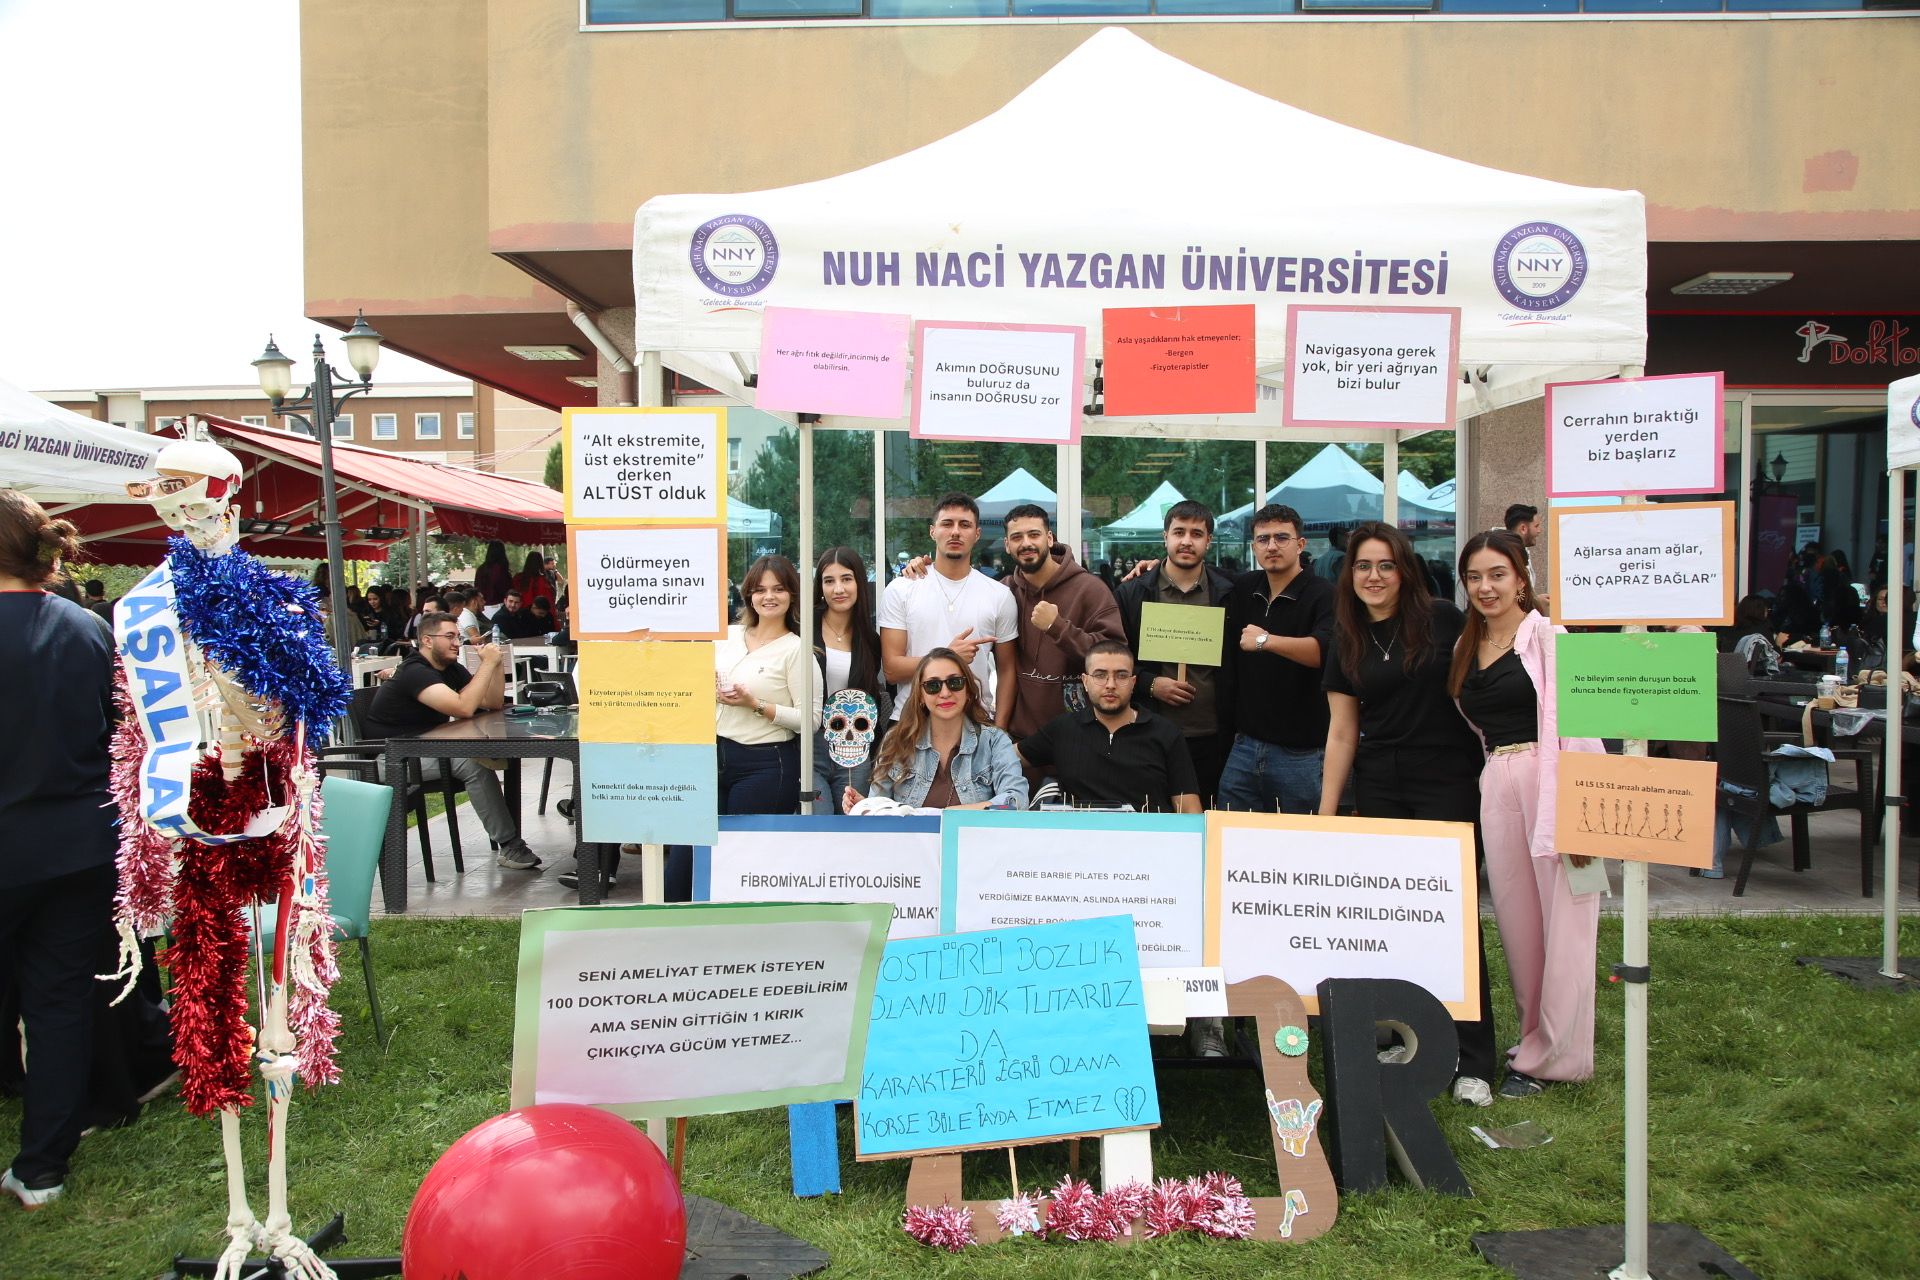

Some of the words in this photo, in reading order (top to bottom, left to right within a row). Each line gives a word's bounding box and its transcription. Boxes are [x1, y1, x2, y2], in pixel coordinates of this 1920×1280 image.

[713, 248, 755, 260] NNY
[823, 251, 900, 286] NUH
[916, 244, 1004, 288] NACİ
[1018, 253, 1165, 289] YAZGAN
[1182, 246, 1448, 295] ÜNİVERSİTESİ
[1518, 258, 1563, 272] NNY
[1829, 320, 1920, 366] Dokto
[1165, 350, 1194, 358] -Bergen
[1306, 344, 1393, 358] Navigasyona
[1397, 346, 1436, 359] gerek
[813, 363, 850, 371] olabilirsin.
[935, 362, 976, 373] Akımın
[979, 362, 1060, 376] DOĞRUSUNU
[1150, 363, 1209, 372] -Fizyoterapistler
[1302, 360, 1330, 374] yok,
[1335, 361, 1353, 372] bir
[1357, 361, 1382, 375] yeri
[1387, 362, 1437, 376] ağrıyan
[967, 377, 1012, 389] buluruz
[1015, 379, 1030, 390] da
[1337, 377, 1361, 389] bizi
[1365, 378, 1401, 390] bulur
[930, 390, 972, 402] insanın
[975, 391, 1037, 404] DOĞRUSU
[1041, 397, 1060, 405] zor
[1563, 413, 1628, 427] Cerrahın
[1634, 408, 1698, 424] bıraktığı
[583, 434, 612, 447] "Alt
[617, 434, 704, 449] ekstremite,
[1605, 429, 1658, 446] yerden
[0, 429, 21, 449] ACİ
[23, 435, 71, 457] YAZGAN
[73, 440, 150, 470] ÜNİVERSİTESİ
[1588, 449, 1610, 461] biz
[1615, 447, 1676, 463] başlarız
[585, 453, 608, 466] üst
[613, 453, 704, 466] ekstremite"
[617, 468, 671, 481] derken
[161, 482, 184, 492] FTR
[583, 483, 653, 500] ALTÜST
[659, 485, 706, 500] olduk
[1574, 546, 1622, 559] Ağlarsa
[1626, 546, 1661, 555] anam
[1665, 544, 1702, 556] ağlar,
[601, 554, 690, 571] Öldürmeyen
[1619, 559, 1655, 573] gerisi
[587, 575, 657, 590] uygulama
[662, 577, 704, 587] sınavı
[1566, 574, 1591, 586] "ÖN
[1595, 575, 1649, 588] ÇAPRAZ
[1654, 572, 1716, 584] BAĞLAR"
[609, 593, 688, 609] güçlendirir
[1587, 675, 1615, 683] bileyim
[1639, 675, 1671, 683] duruşun
[1623, 687, 1671, 696] fizyoterapist
[120, 570, 207, 839] AŞALLAH
[741, 872, 826, 888] FİBROMİYALJİ
[829, 873, 921, 888] ETİYOLOJİSİNE
[1006, 870, 1038, 878] BARBİE
[1041, 871, 1072, 879] BARBİE
[1074, 872, 1109, 880] PİLATES
[1113, 873, 1150, 881] POZLARI
[1228, 869, 1287, 885] KALBİN
[1293, 872, 1401, 890] KIRILDIĞINDA
[1406, 876, 1453, 892] DEĞİL
[979, 893, 1033, 902] VERDİĞİMİZE
[1151, 897, 1176, 905] HARBİ
[1232, 900, 1331, 918] KEMİKLERİN
[1337, 906, 1445, 923] KIRILDIĞINDA
[1132, 920, 1164, 929] IKIYOR.
[1289, 936, 1322, 950] GEL
[1327, 937, 1388, 952] YANIMA
[882, 937, 1003, 982] OSTÜRÜ
[1016, 937, 1122, 972] BOZUK
[579, 968, 616, 982] SENİ
[620, 965, 699, 980] AMELİYAT
[703, 963, 756, 975] ETMEK
[761, 960, 825, 973] İSTEYEN
[547, 998, 573, 1009] 100
[579, 993, 668, 1008] DOKTORLA
[672, 987, 758, 1002] MÜCADELE
[763, 980, 848, 996] EDEBİLİRİM
[959, 986, 1009, 1017] DİK
[1017, 980, 1139, 1014] TUTARIZ
[590, 1021, 626, 1033] AMA
[630, 1016, 677, 1030] SENİN
[682, 1011, 747, 1027] GİTTİĞİN
[753, 1012, 758, 1022] 1
[765, 1008, 804, 1021] KIRIK
[587, 1044, 665, 1060] ÇIKIKÇIYA
[670, 1038, 726, 1053] GÜCÜM
[731, 1033, 801, 1048] YETMEZ...
[955, 1028, 1007, 1062] DA
[860, 1059, 986, 1100] KARAKTERİ
[1049, 1053, 1120, 1076] OLANA
[861, 1112, 920, 1139] KORSE
[927, 1110, 972, 1133] BİLE
[1027, 1094, 1106, 1120] ETMEZ
